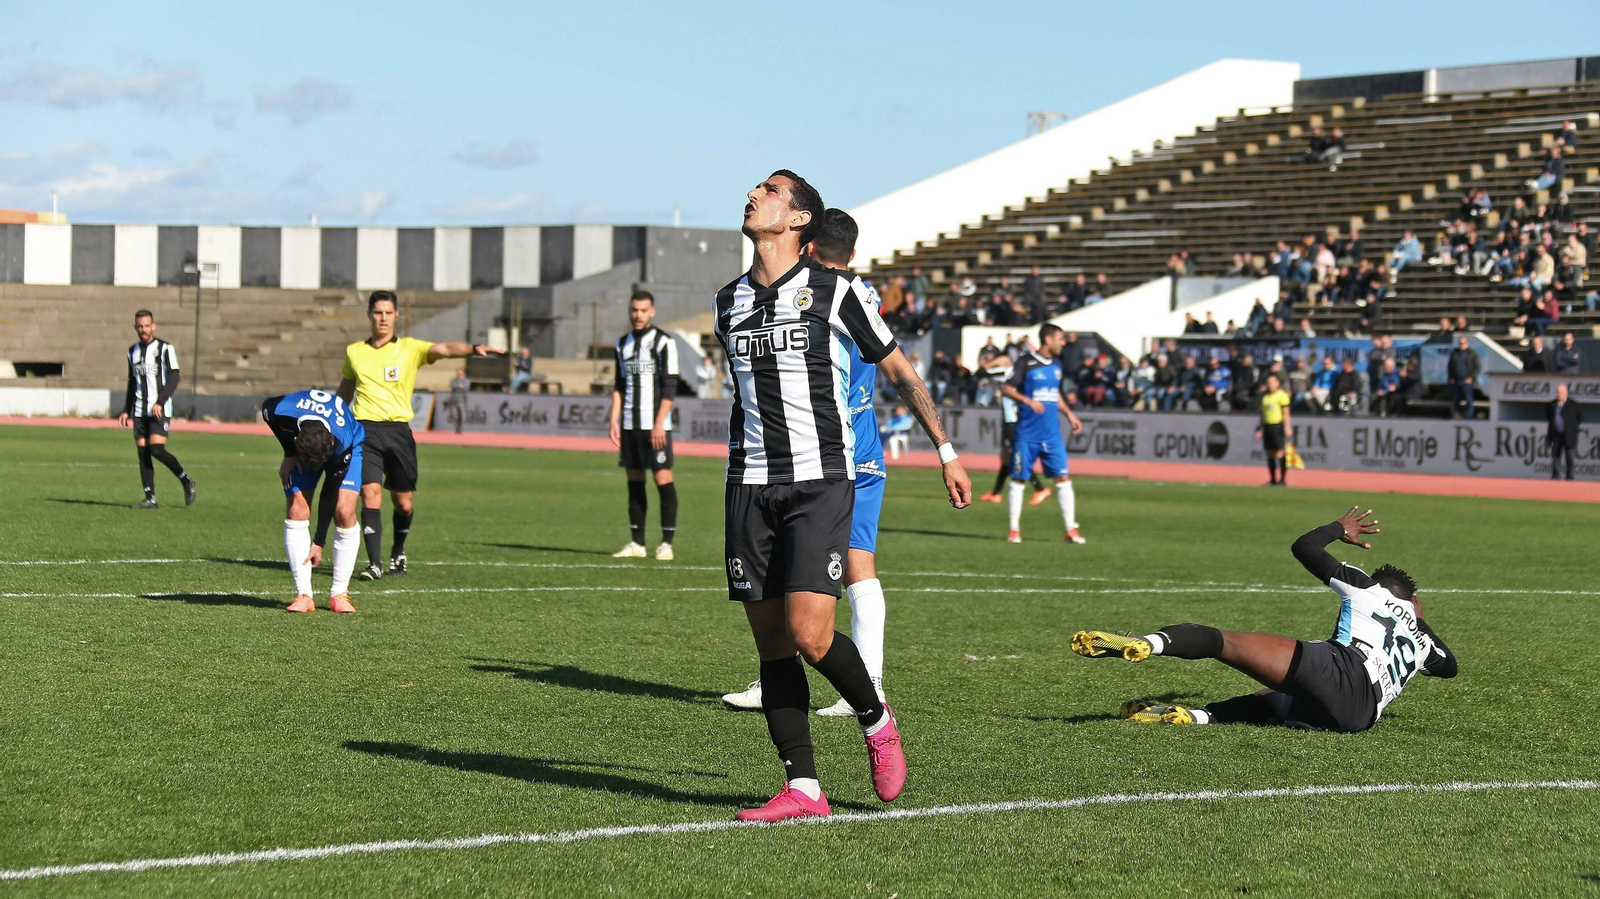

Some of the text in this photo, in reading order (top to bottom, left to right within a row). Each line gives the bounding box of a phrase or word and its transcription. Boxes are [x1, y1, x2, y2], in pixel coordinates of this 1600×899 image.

[1503, 380, 1551, 395] LEGEA
[296, 398, 333, 418] POLEY
[1095, 433, 1136, 456] LACSE
[1154, 432, 1203, 460] GPON
[1353, 427, 1438, 465] El Monje
[1495, 426, 1553, 466] Roja
